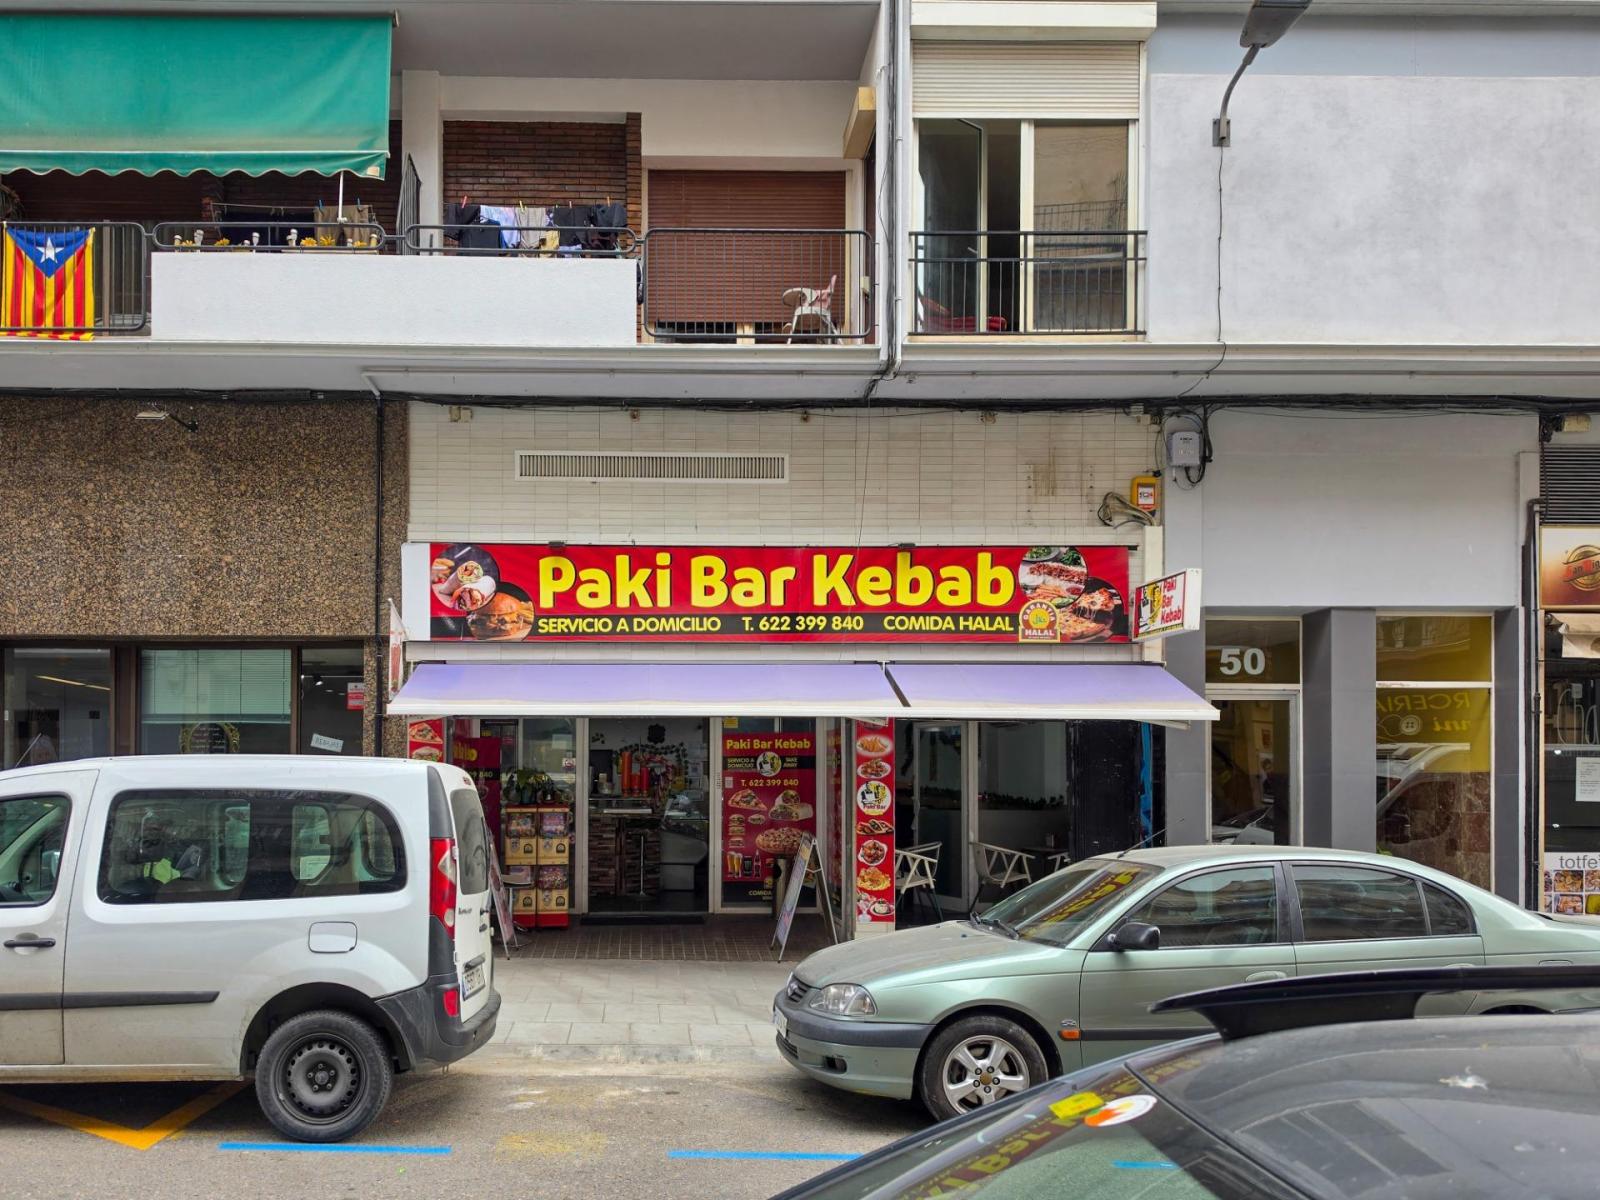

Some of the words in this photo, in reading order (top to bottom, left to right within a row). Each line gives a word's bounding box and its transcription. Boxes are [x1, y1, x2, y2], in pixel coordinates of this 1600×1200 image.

[539, 552, 671, 609] Paki
[690, 555, 796, 608] Bar
[812, 551, 1015, 607] Kebab
[1163, 576, 1177, 592] Paki
[1162, 594, 1174, 609] Bar
[538, 617, 613, 633] SERVICIO
[616, 617, 630, 632] A
[633, 616, 722, 632] DOMICILIO
[742, 616, 754, 632] T.
[759, 615, 790, 631] 622
[795, 615, 827, 631] 399
[831, 615, 864, 631] 840
[883, 615, 956, 631] COMIDA
[960, 615, 1014, 631] HALAL
[1161, 606, 1182, 625] Kebab
[1219, 648, 1266, 676] 50
[727, 739, 751, 749] Paki
[753, 739, 773, 749] Bar
[775, 738, 811, 749] Kebab
[749, 779, 764, 787] 622
[766, 779, 782, 787] 399
[783, 779, 799, 787] 840
